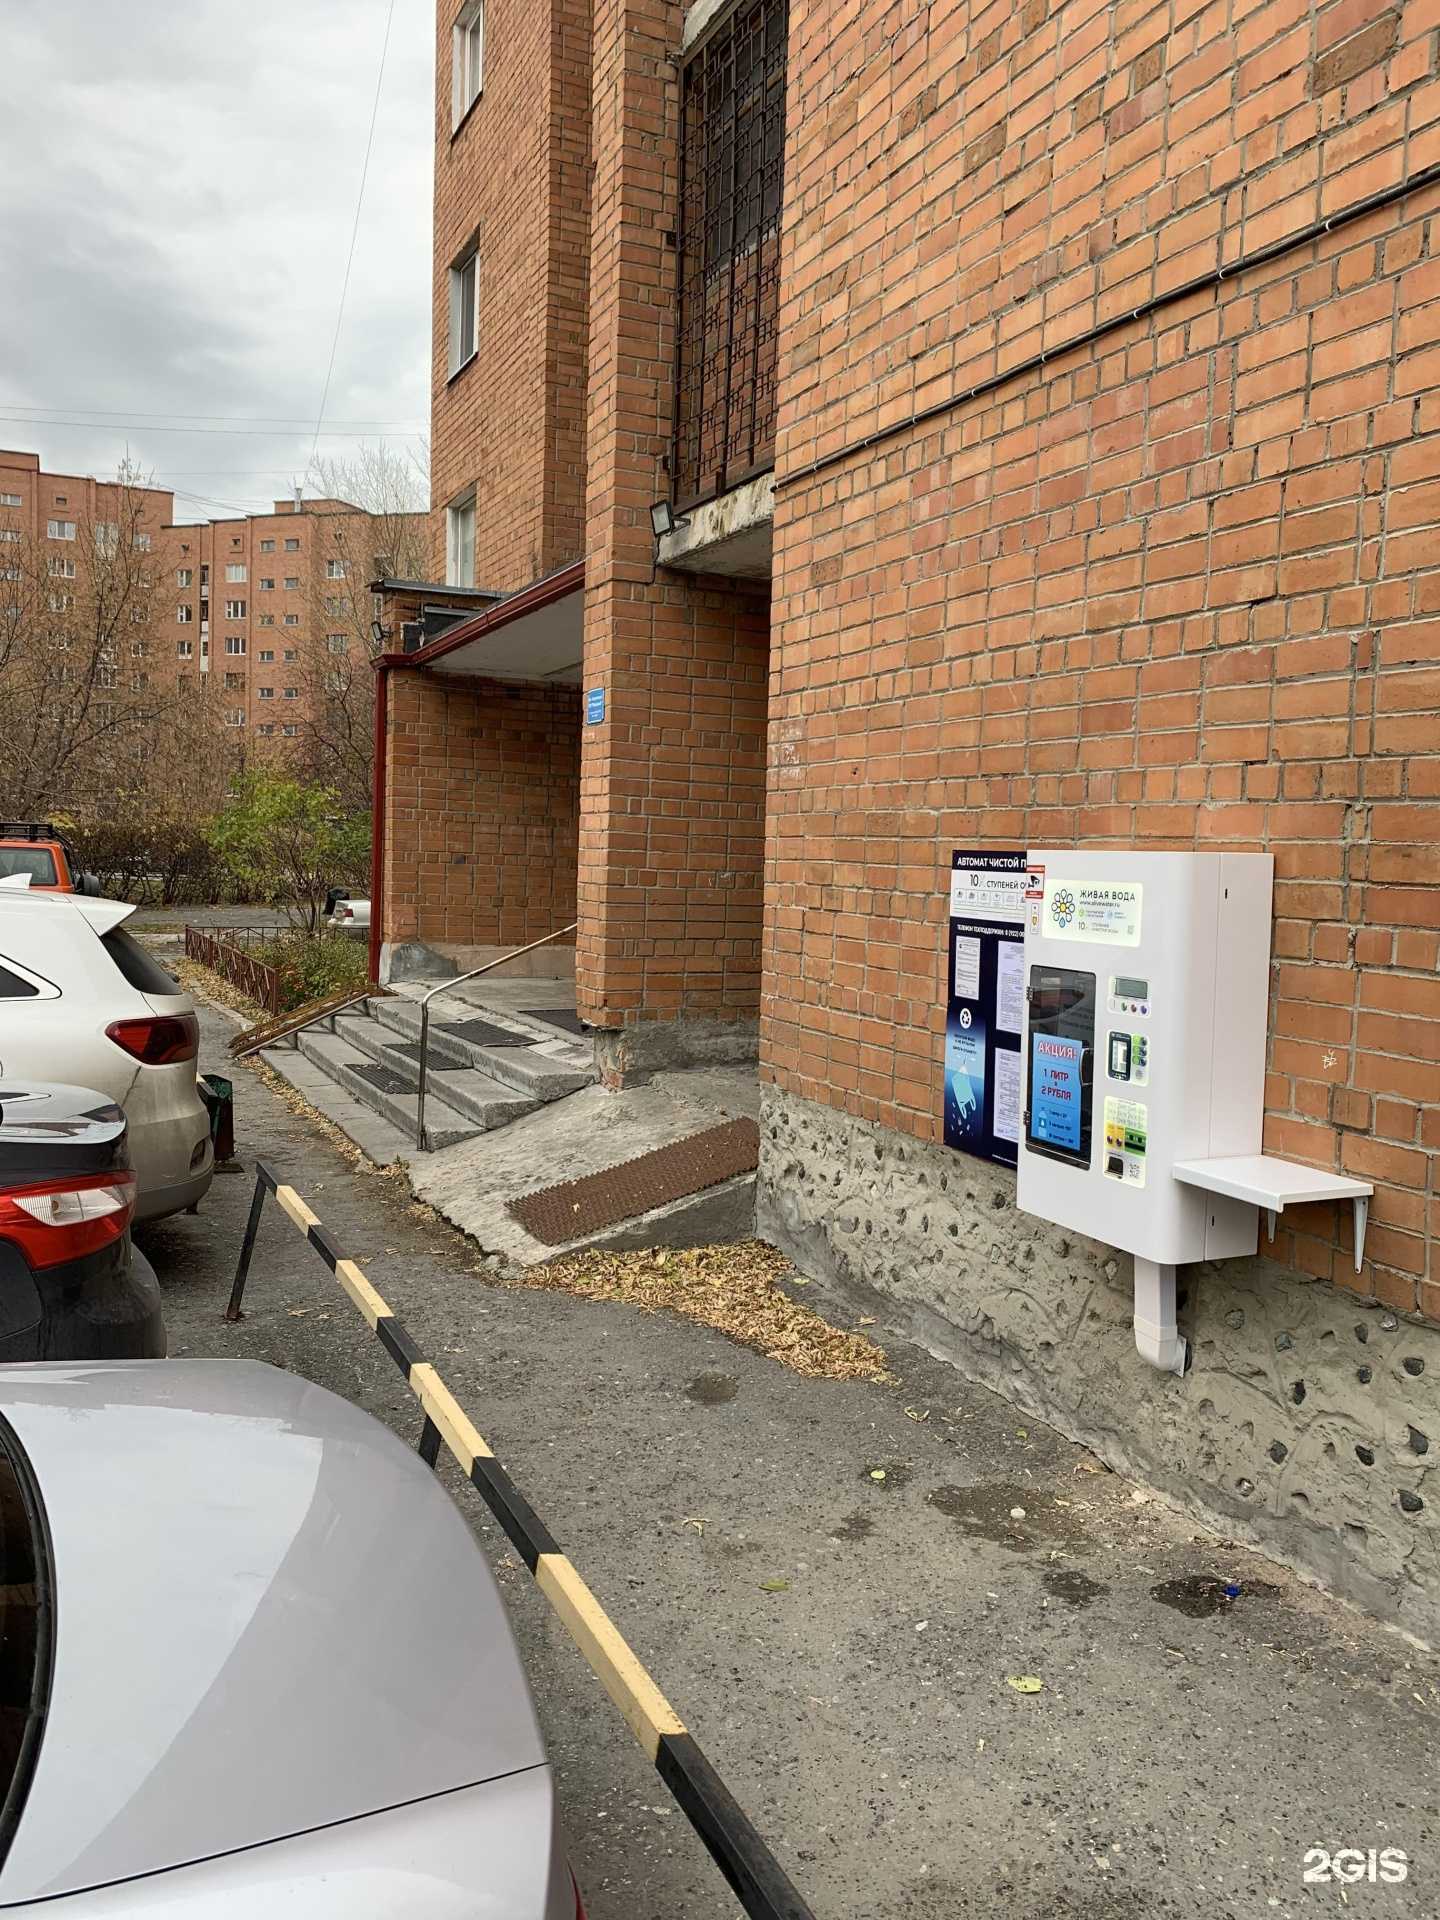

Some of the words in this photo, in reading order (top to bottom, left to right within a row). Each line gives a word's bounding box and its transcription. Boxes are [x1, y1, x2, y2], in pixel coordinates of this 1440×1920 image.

[957, 857, 989, 867] АВТОМАТ
[989, 857, 1019, 868] ЧИСТОЙ
[986, 880, 1018, 889] СТУПЕНЕЙ
[1080, 890, 1109, 899] ЖИВАЯ
[1112, 891, 1136, 901] ВОДА
[1041, 1085, 1046, 1094] 2
[1048, 1087, 1071, 1100] РУБЛЯ
